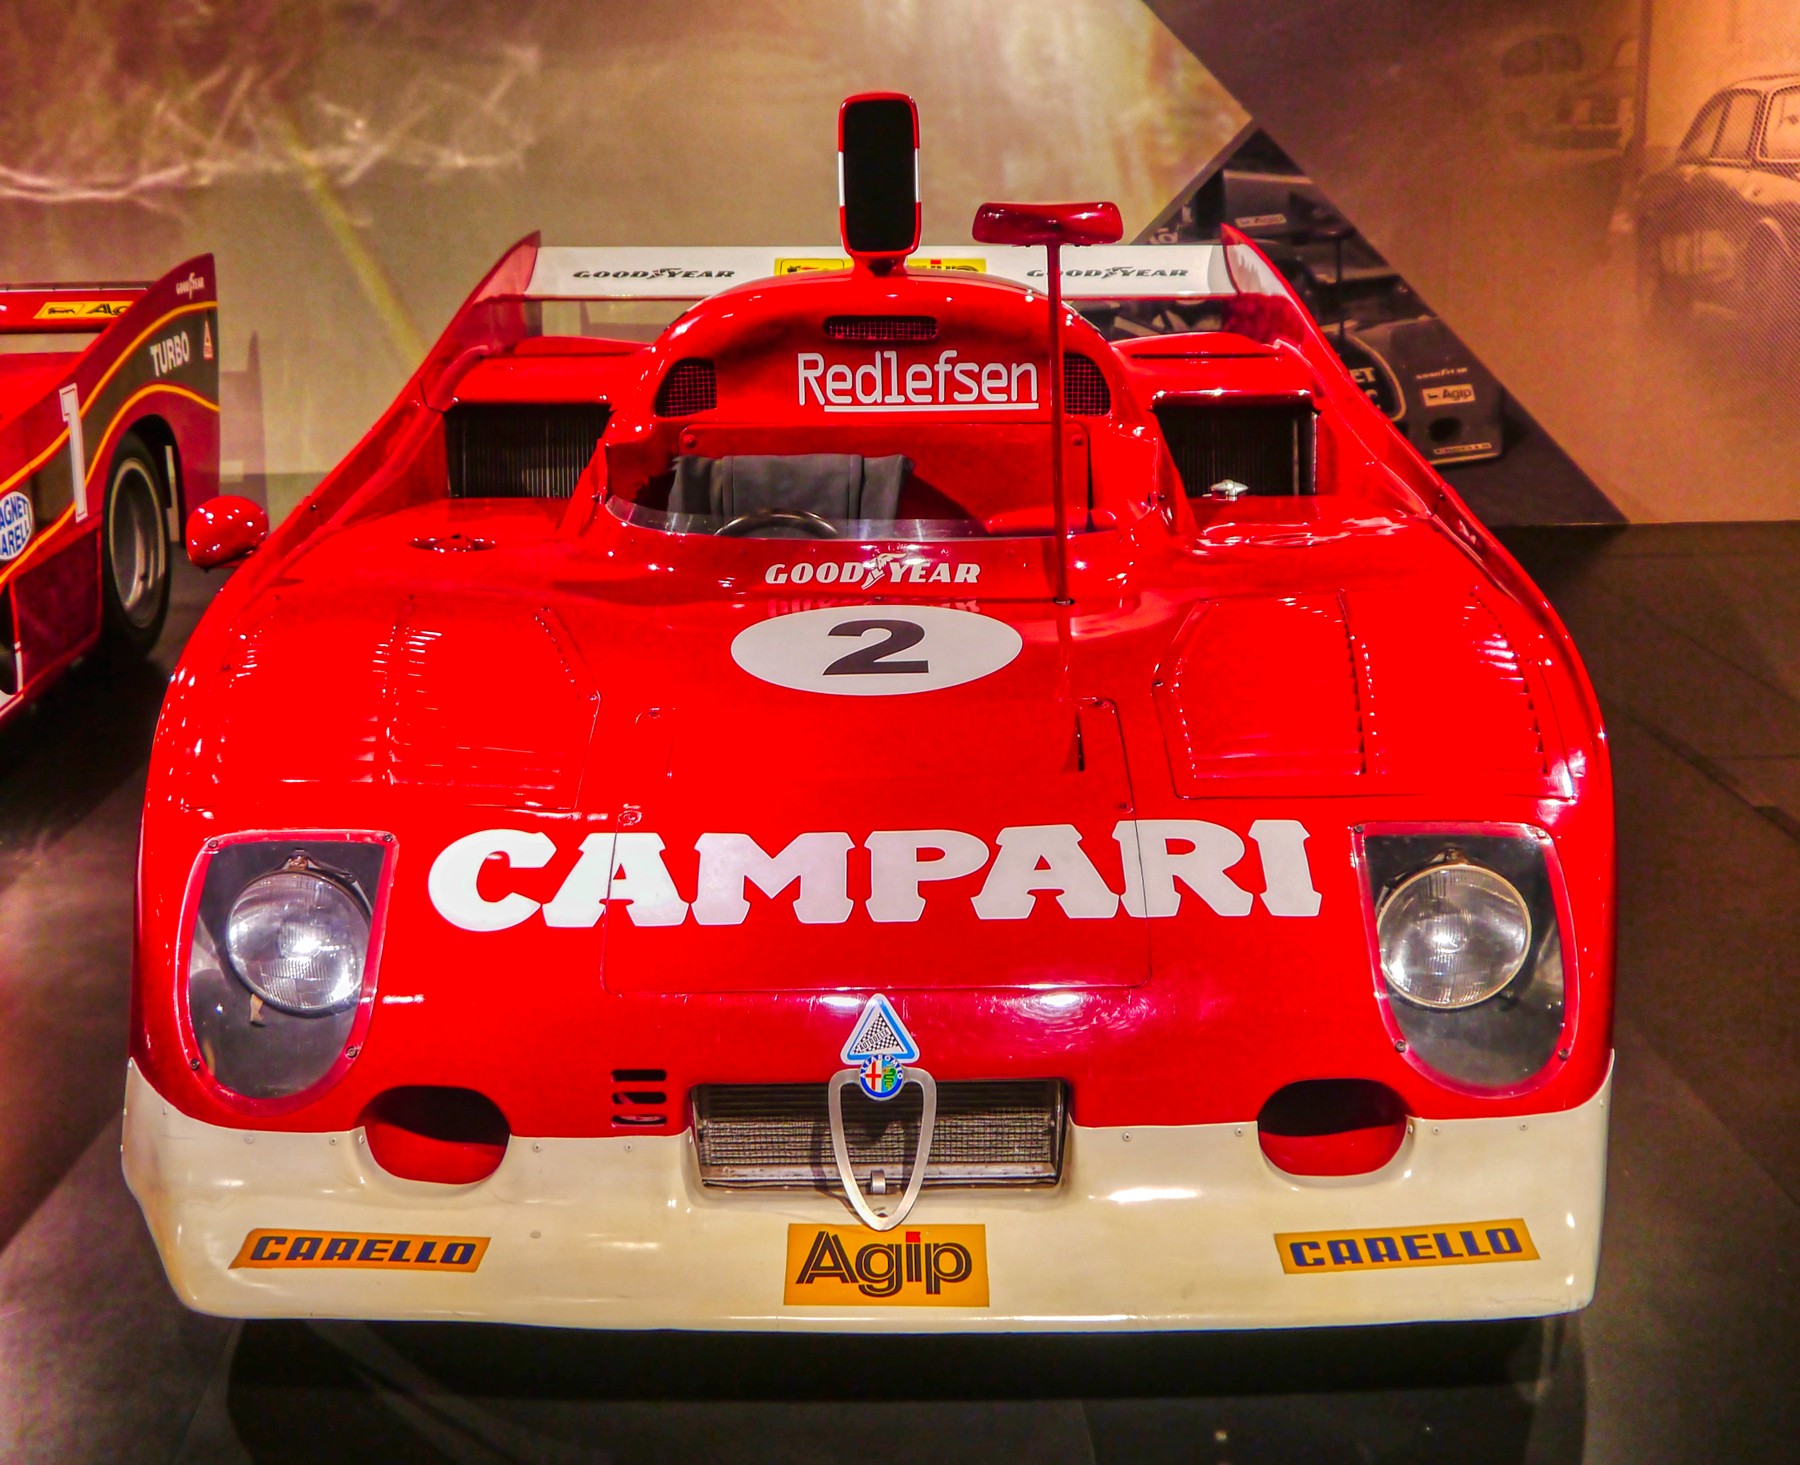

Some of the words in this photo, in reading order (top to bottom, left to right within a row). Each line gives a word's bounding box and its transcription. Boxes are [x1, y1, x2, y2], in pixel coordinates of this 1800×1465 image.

[573, 269, 735, 279] GOODYEAR
[1027, 267, 1188, 279] GODYEAR
[150, 331, 190, 377] TURBO
[798, 350, 1038, 406] Redlefsen
[59, 382, 88, 523] 1
[765, 559, 981, 585] GOODYEAR
[823, 619, 929, 676] 2
[428, 819, 1322, 932] CAMPARI
[250, 1236, 477, 1265] CARELLO
[796, 1231, 973, 1298] Agip
[1290, 1228, 1523, 1267] CARELLO
